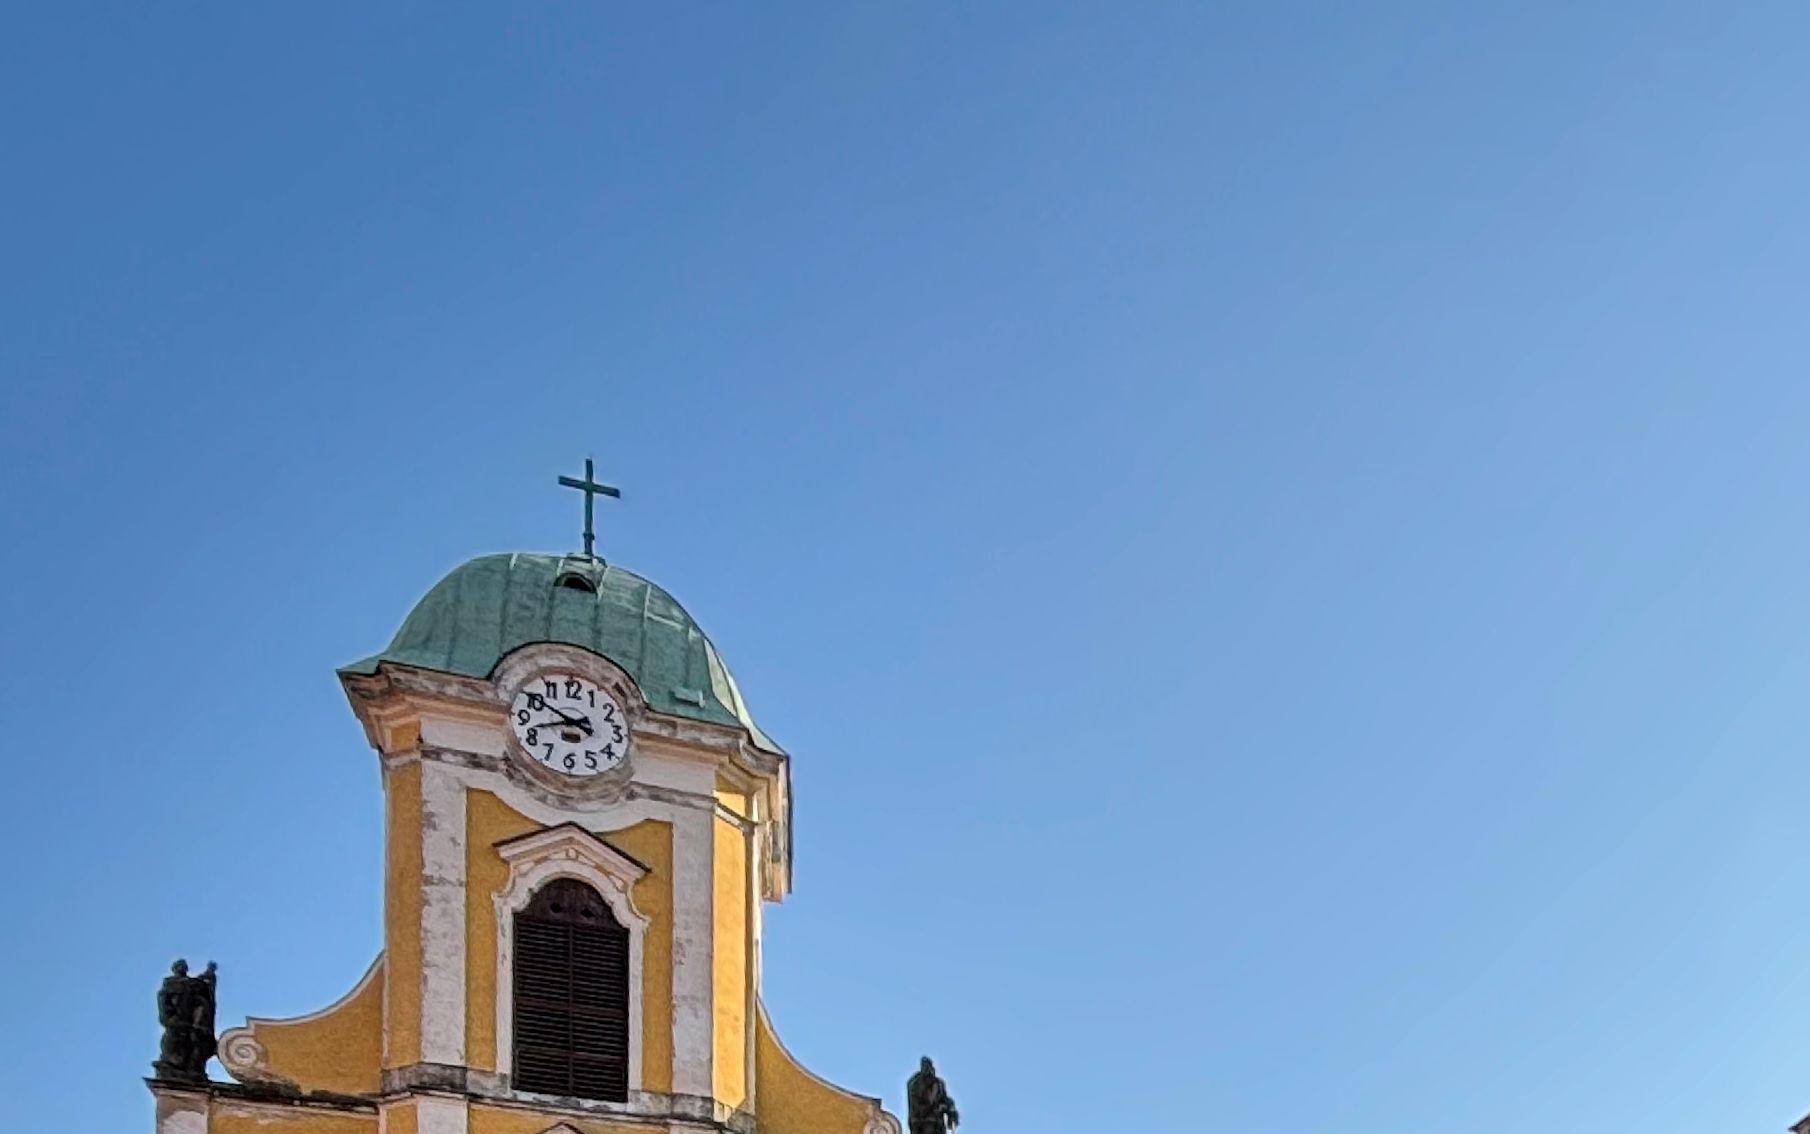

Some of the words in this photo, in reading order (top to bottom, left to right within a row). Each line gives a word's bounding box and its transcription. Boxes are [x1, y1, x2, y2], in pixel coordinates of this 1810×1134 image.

[545, 681, 558, 700] 11
[564, 680, 582, 700] 12
[587, 690, 595, 708] 1
[527, 693, 544, 711] 10
[517, 709, 530, 726] 9
[602, 703, 615, 723] 2
[526, 728, 538, 746] 8
[612, 724, 623, 743] 3
[542, 743, 554, 761] 7
[585, 750, 597, 769] 5
[600, 743, 616, 760] 4
[563, 752, 577, 770] 6
